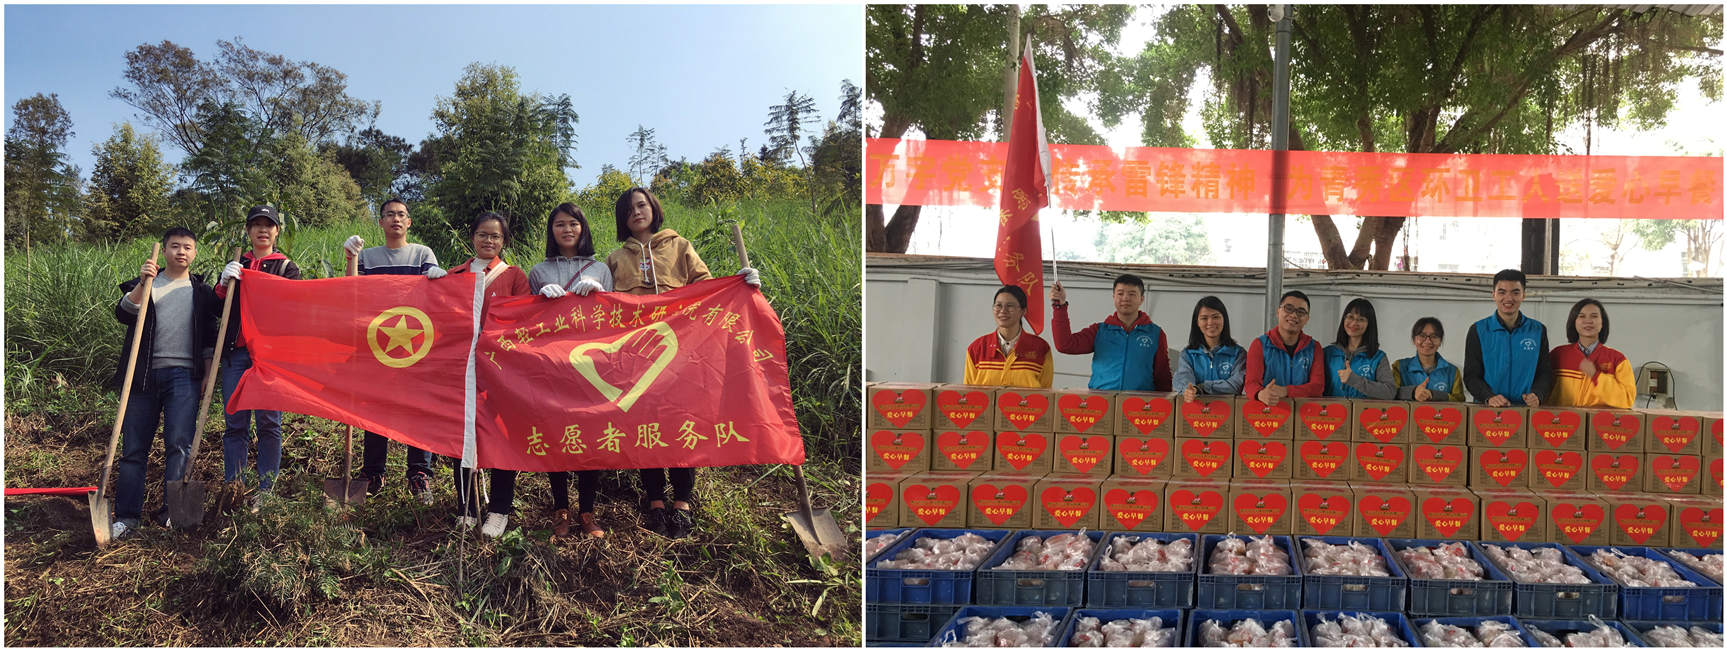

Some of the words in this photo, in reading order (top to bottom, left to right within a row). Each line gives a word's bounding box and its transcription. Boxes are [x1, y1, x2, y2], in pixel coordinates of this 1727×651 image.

[483, 301, 774, 371] 广西轻工业科学技术研院有限公司
[526, 420, 750, 456] 志愿者服务队
